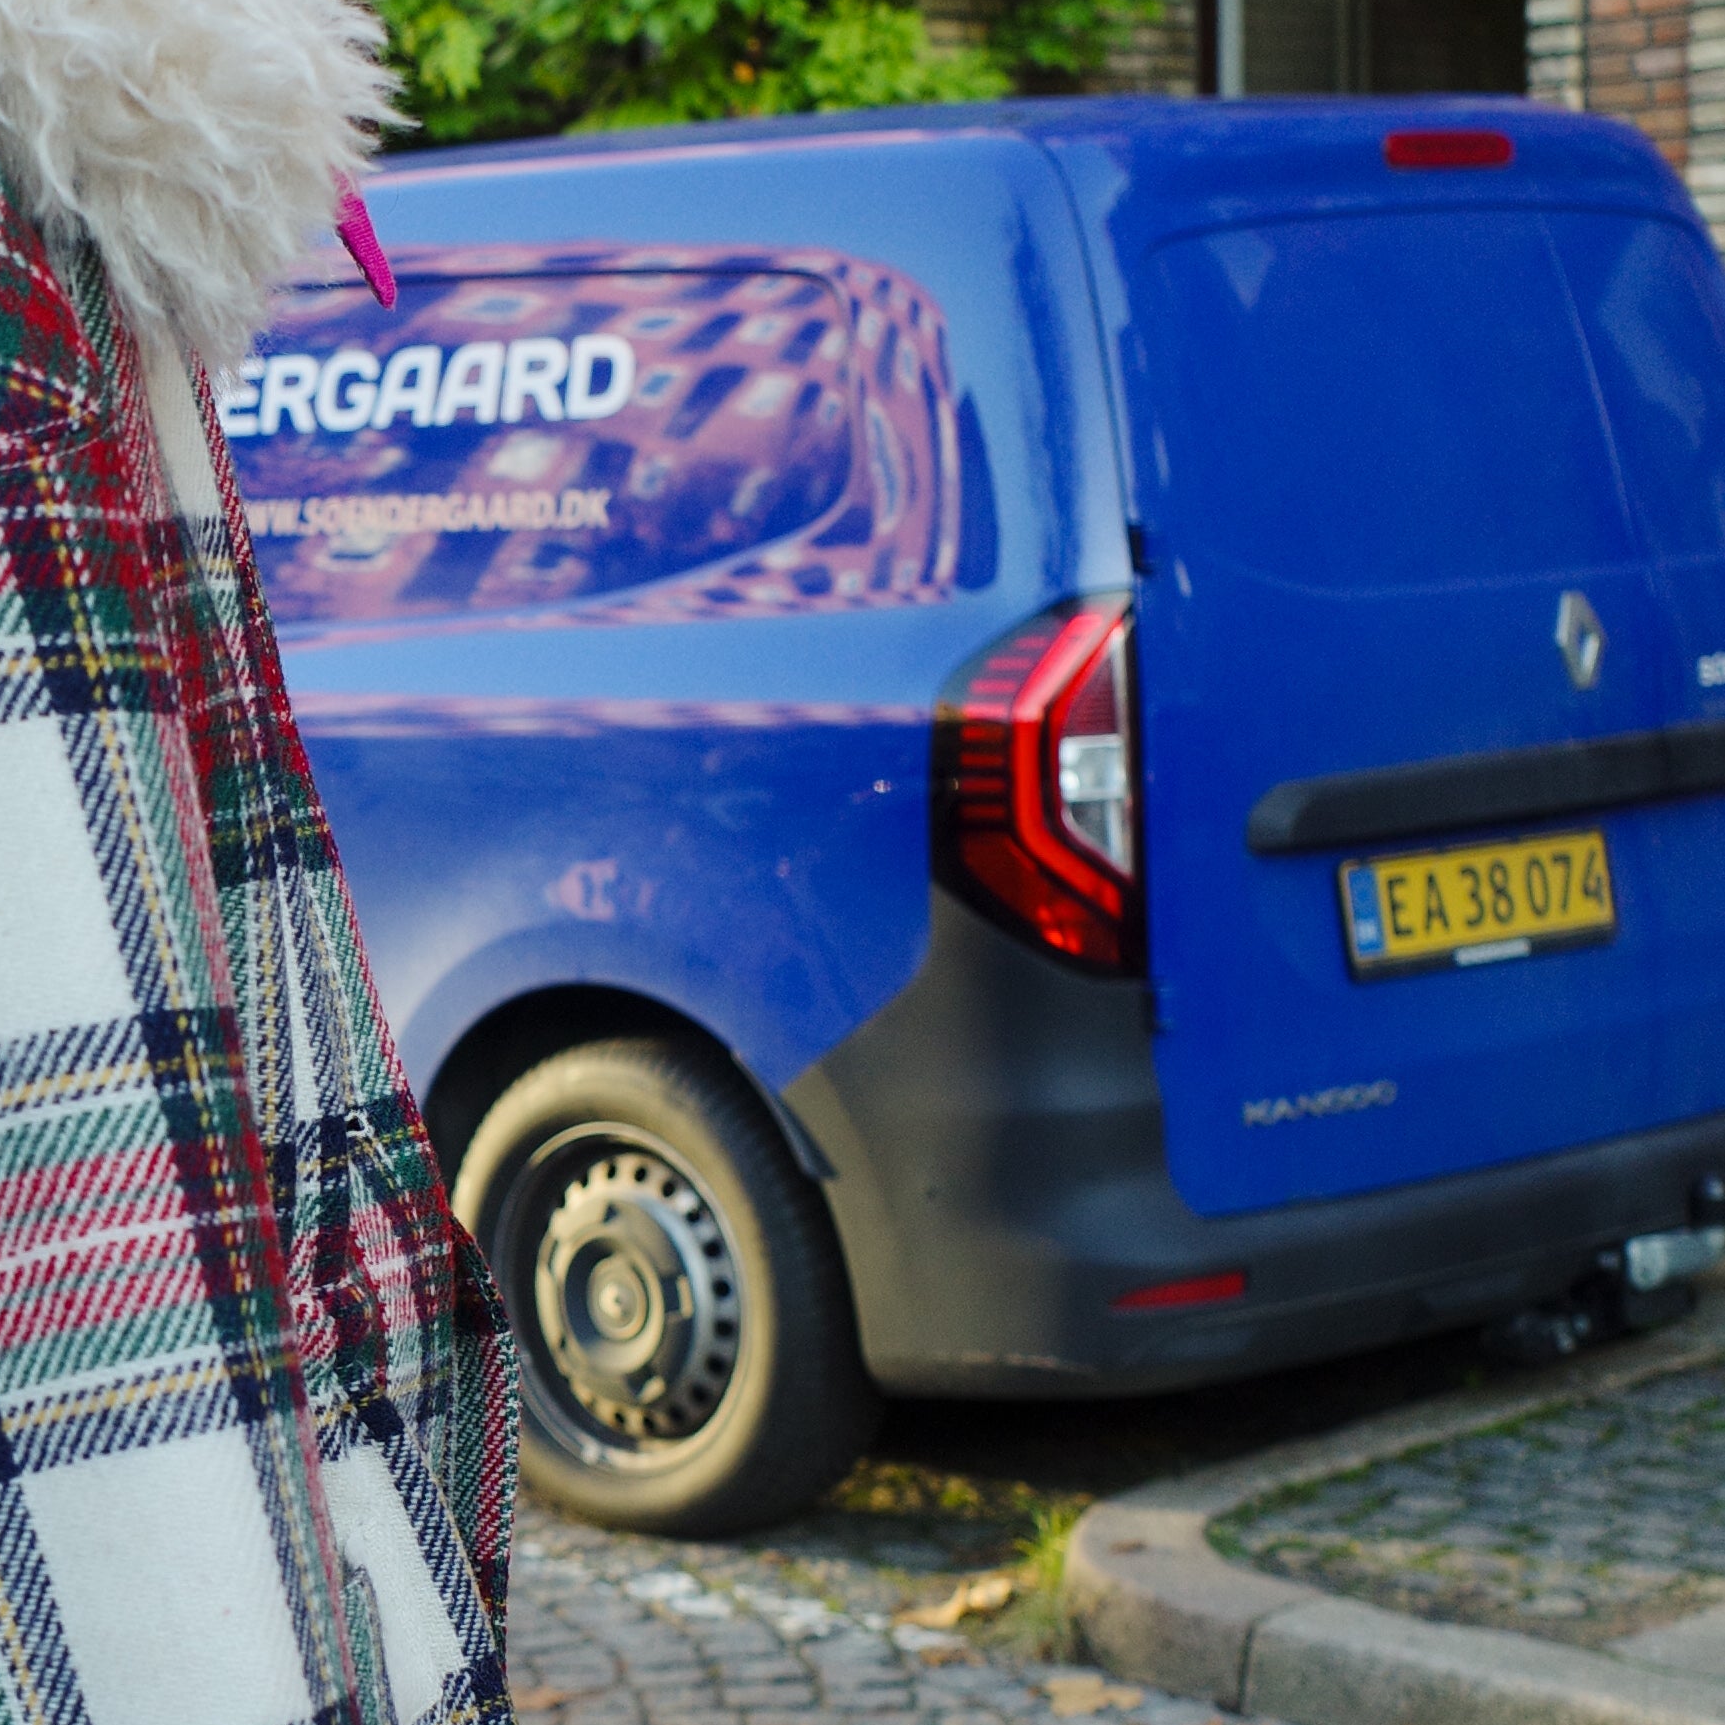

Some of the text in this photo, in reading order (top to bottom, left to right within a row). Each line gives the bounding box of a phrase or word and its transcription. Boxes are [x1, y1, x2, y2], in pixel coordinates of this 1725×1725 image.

[1385, 846, 1606, 938] EA 38 074
